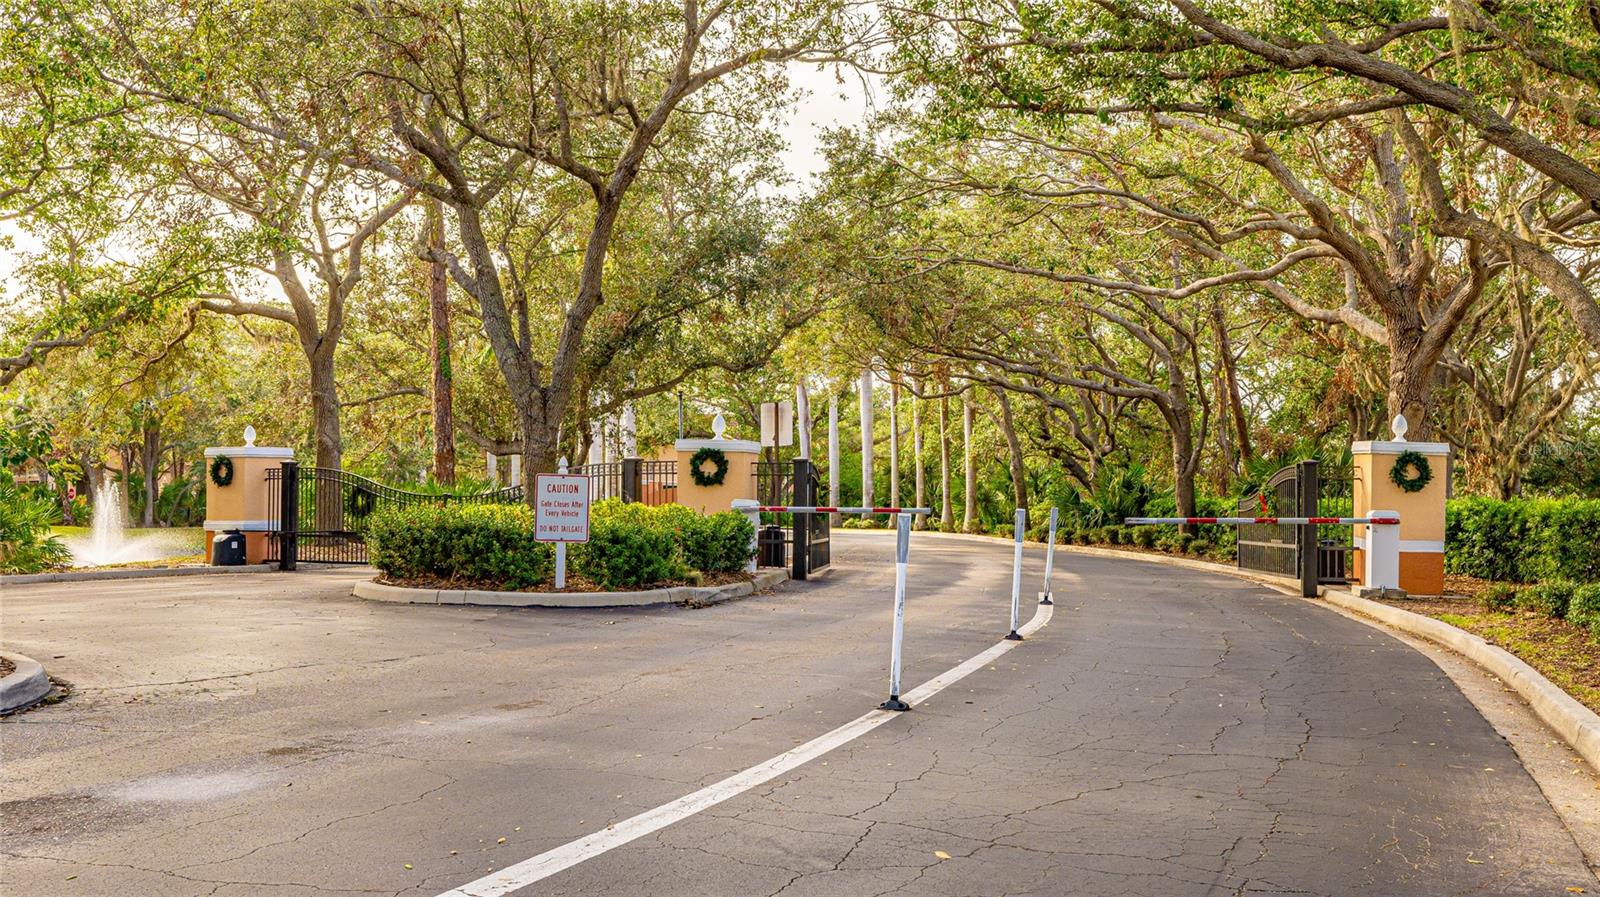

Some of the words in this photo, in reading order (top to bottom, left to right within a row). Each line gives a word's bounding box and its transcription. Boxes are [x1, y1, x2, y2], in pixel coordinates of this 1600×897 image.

[547, 483, 579, 494] CAUTION
[554, 500, 570, 508] Closes
[545, 509, 560, 517] Every
[561, 525, 583, 533] TAILGATE
